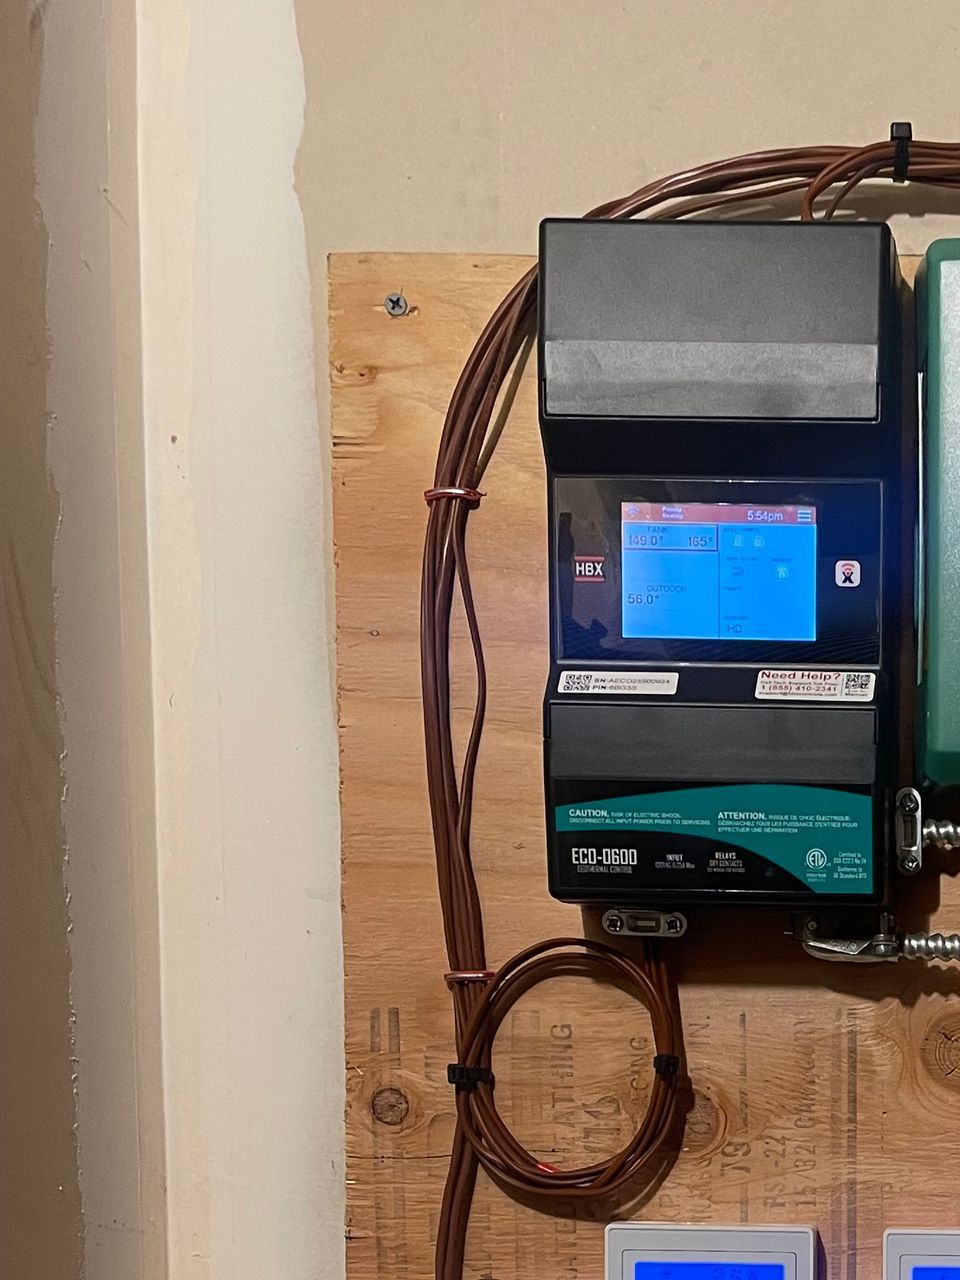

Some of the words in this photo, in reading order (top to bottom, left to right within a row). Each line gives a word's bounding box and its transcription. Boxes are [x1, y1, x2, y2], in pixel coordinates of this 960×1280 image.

[575, 562, 604, 577] HBX
[761, 671, 796, 680] Need
[801, 672, 841, 682] Help?
[571, 847, 638, 866] ECO-0600
[666, 853, 683, 862] INPUT
[714, 851, 737, 860] RELAYS
